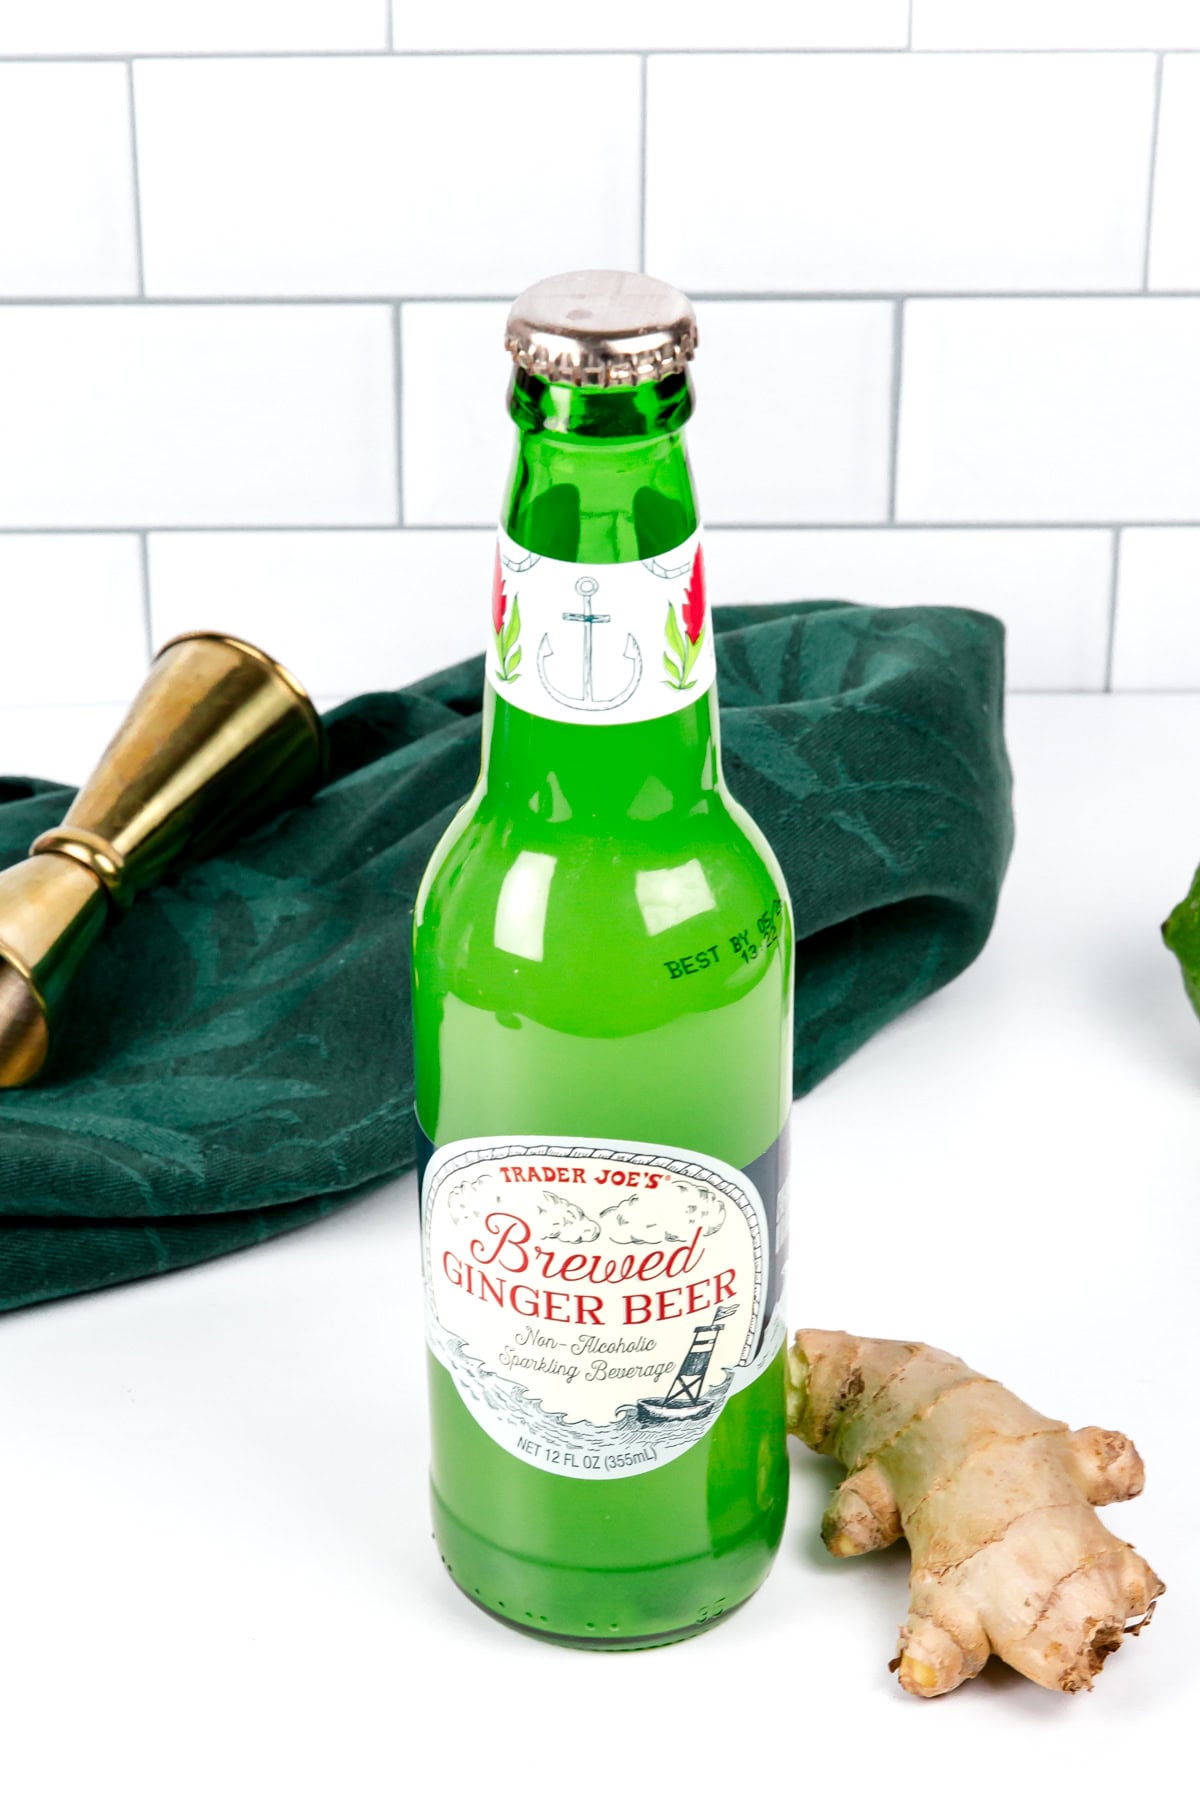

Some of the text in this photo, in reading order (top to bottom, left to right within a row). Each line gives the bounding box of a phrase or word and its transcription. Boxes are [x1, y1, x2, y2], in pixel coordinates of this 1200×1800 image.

[664, 945, 720, 979] BEST
[729, 930, 748, 953] BY
[500, 1167, 664, 1188] TRADER JOE'S
[470, 1212, 708, 1284] Brewed
[442, 1249, 738, 1326] GINGER BEER
[498, 1346, 676, 1383] Sparkling Beverage
[517, 1436, 657, 1472] NET 12 FL OZ (355mL)
